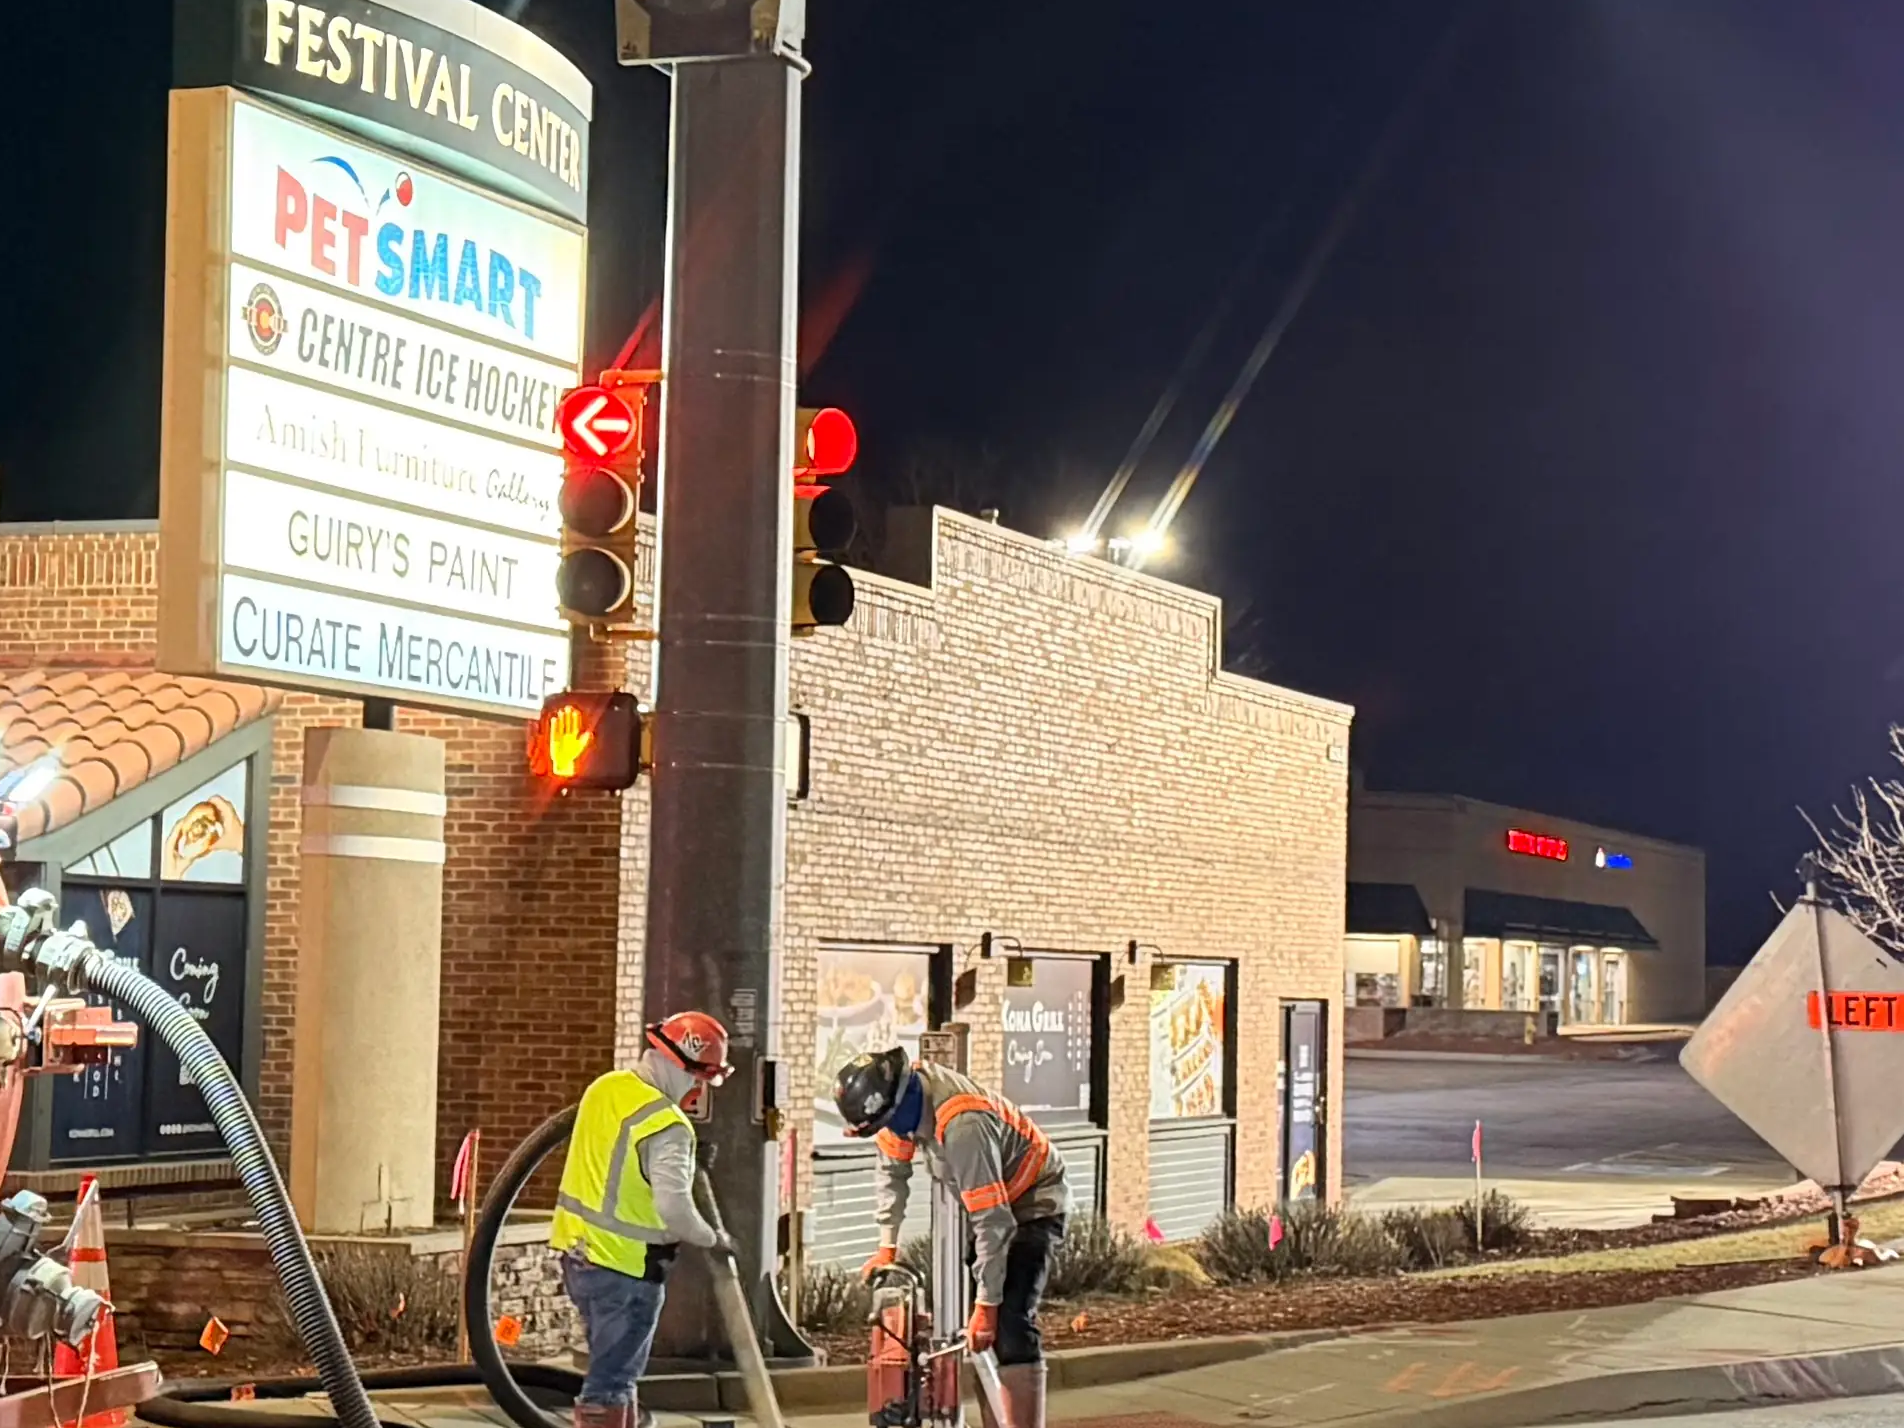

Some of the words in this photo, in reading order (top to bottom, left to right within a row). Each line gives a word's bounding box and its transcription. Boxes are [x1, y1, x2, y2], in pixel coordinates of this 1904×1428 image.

[491, 82, 582, 193] CENTER
[297, 307, 407, 390] CENTRE
[415, 344, 460, 404] ICE
[256, 403, 346, 463] Amish
[485, 468, 550, 522] Gallery
[288, 509, 411, 579] GUIRY'S
[428, 540, 519, 600] PAINT
[232, 595, 362, 673] CURATE
[377, 621, 557, 701] MERCANTILE
[170, 947, 220, 1004] Coming
[1826, 995, 1898, 1026] LEFT
